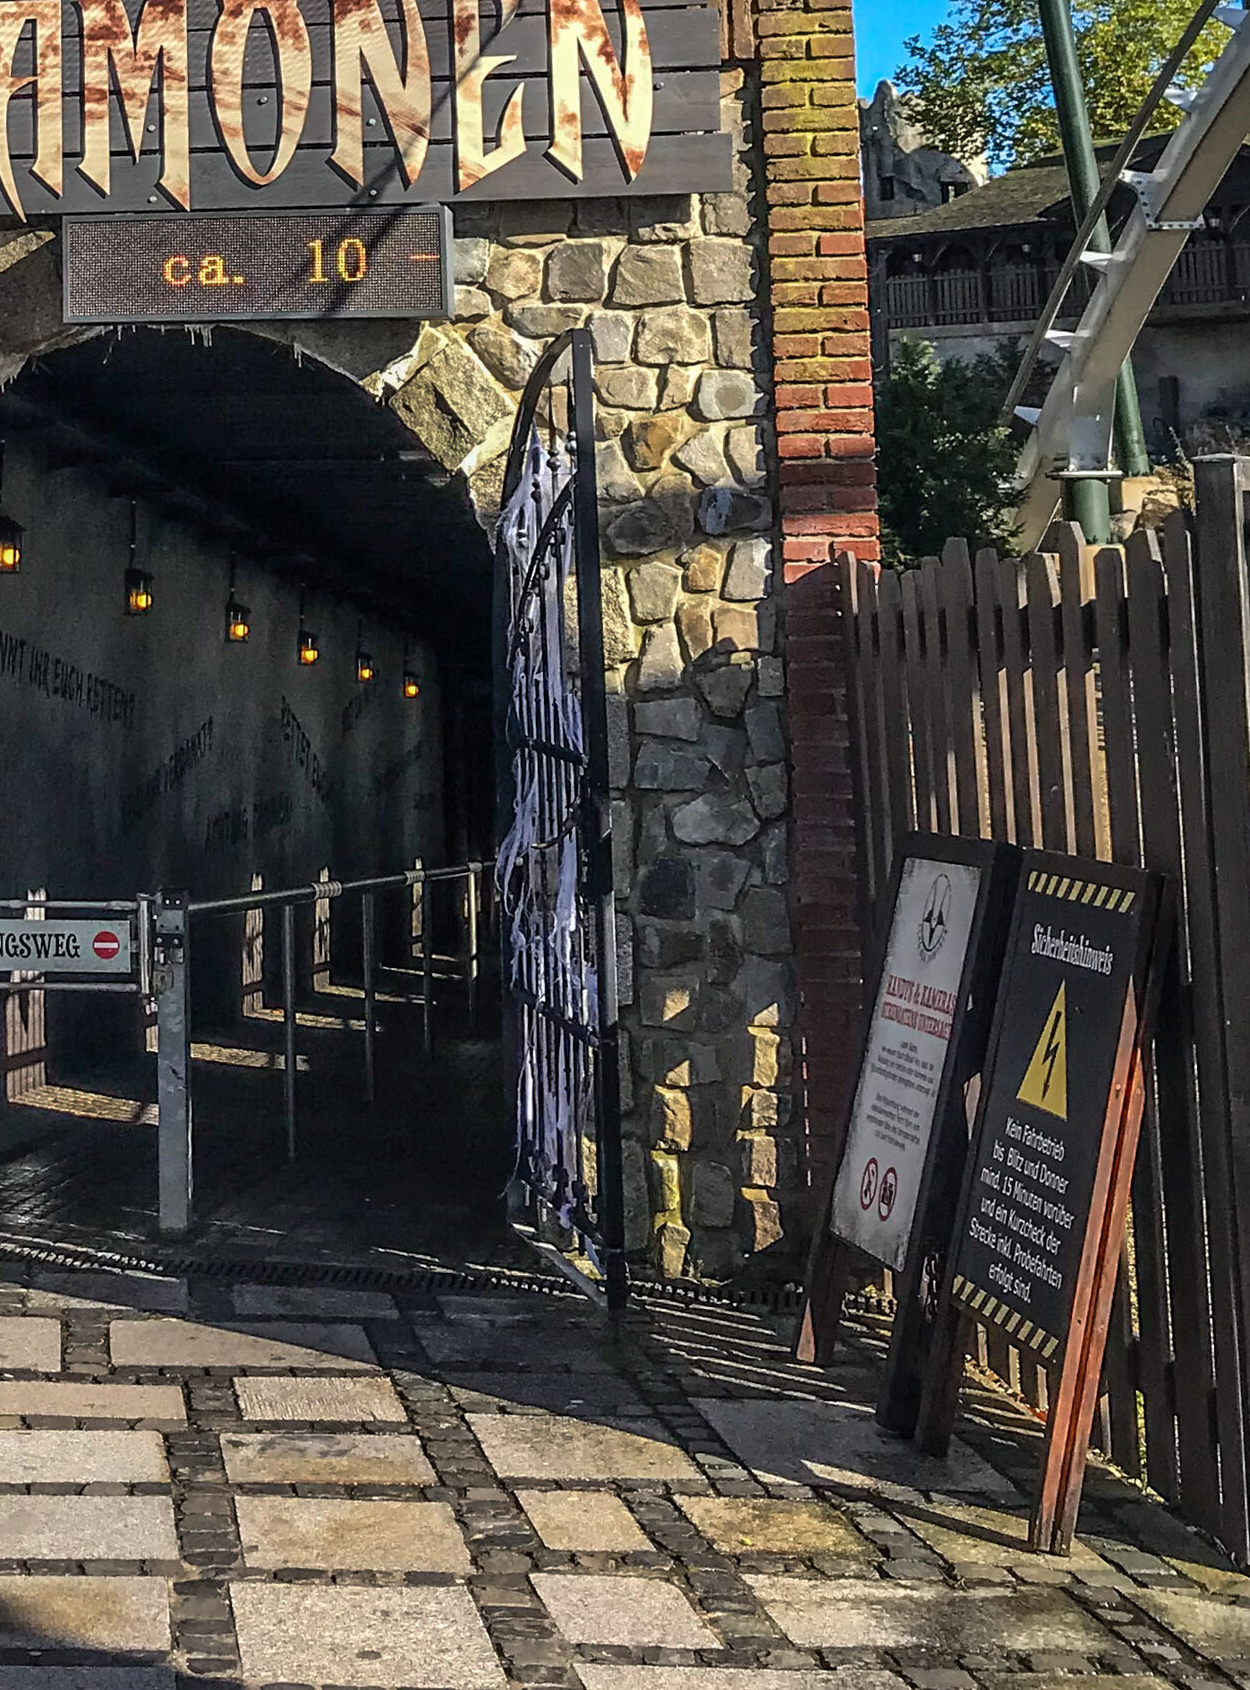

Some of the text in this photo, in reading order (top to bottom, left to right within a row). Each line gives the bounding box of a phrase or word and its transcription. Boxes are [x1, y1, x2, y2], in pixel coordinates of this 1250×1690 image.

[162, 238, 370, 290] ca. 10
[1031, 923, 1114, 975] Sicherheitshinweis
[1005, 1116, 1065, 1162] Kein Fahrbetrieb
[992, 1139, 1069, 1195] bis Blitz und Donner
[980, 1167, 1075, 1230] mind. 15 Minuten vorüber
[980, 1197, 1062, 1255] und ein Kurzcheck der
[968, 1217, 1063, 1290] Strecke inkl. Probefahrten
[988, 1262, 1032, 1303] erfolgt sind.
